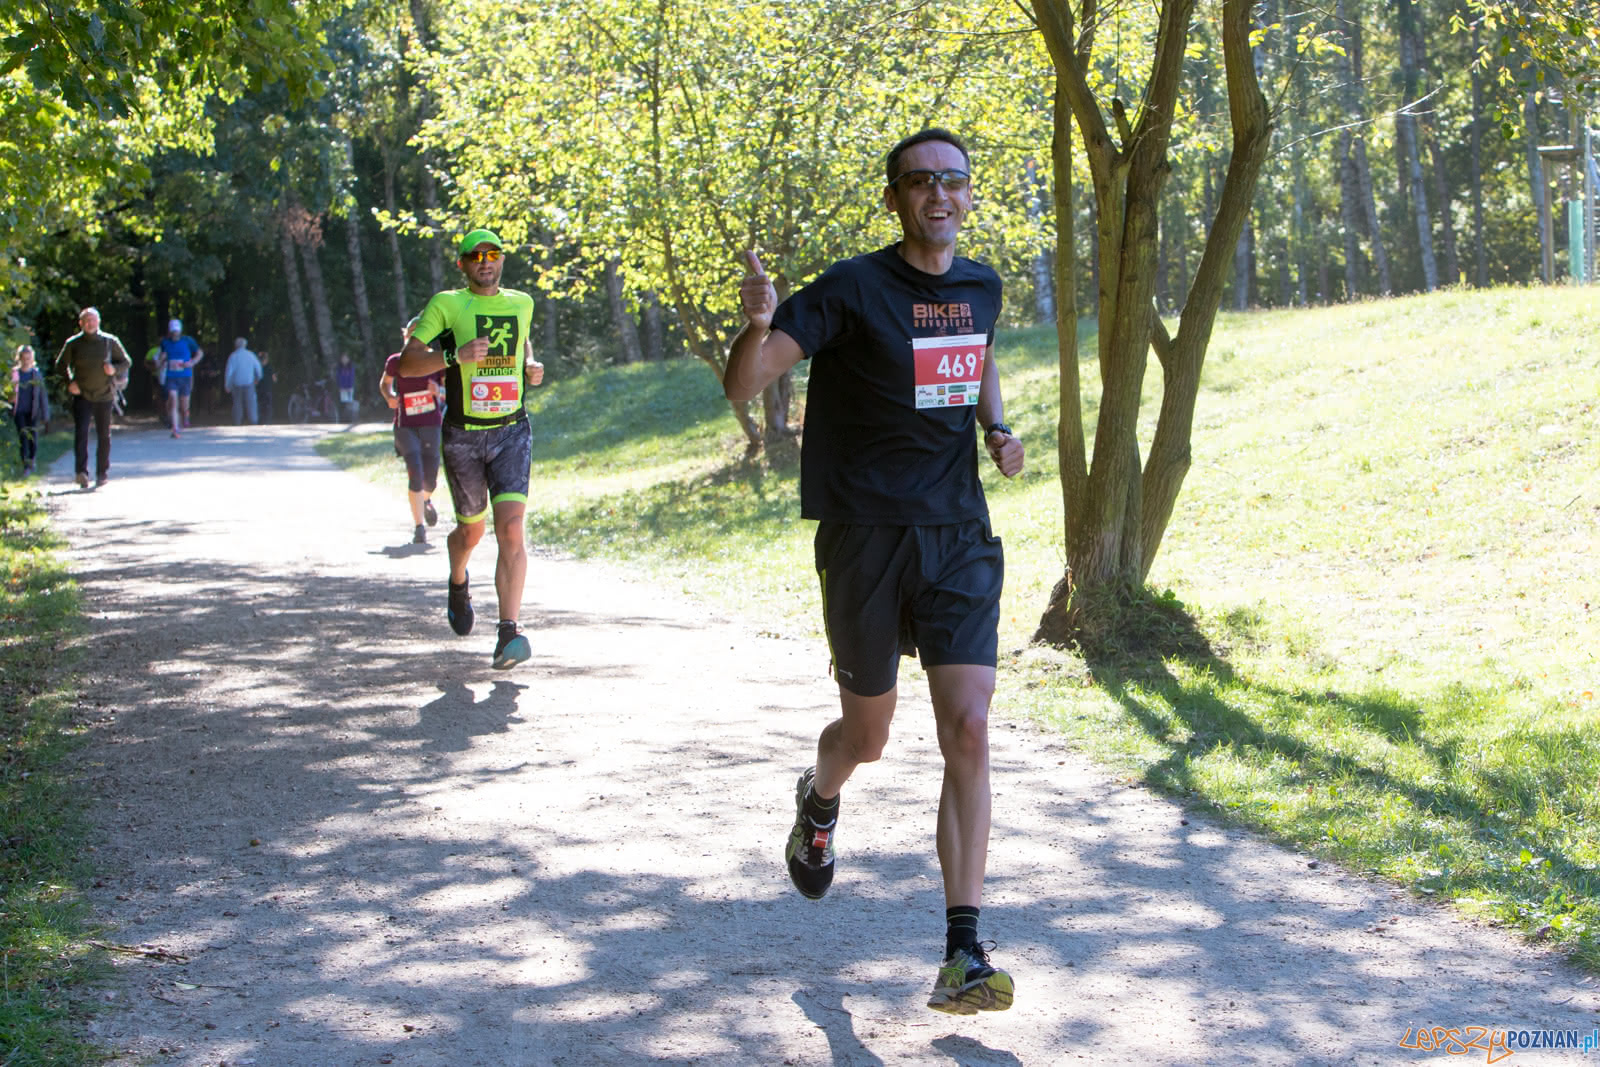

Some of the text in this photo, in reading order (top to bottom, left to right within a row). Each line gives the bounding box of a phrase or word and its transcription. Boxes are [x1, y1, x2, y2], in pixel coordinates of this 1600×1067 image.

[912, 303, 960, 319] BIKE
[485, 355, 512, 367] night
[936, 352, 977, 378] 469
[492, 386, 502, 401] 3
